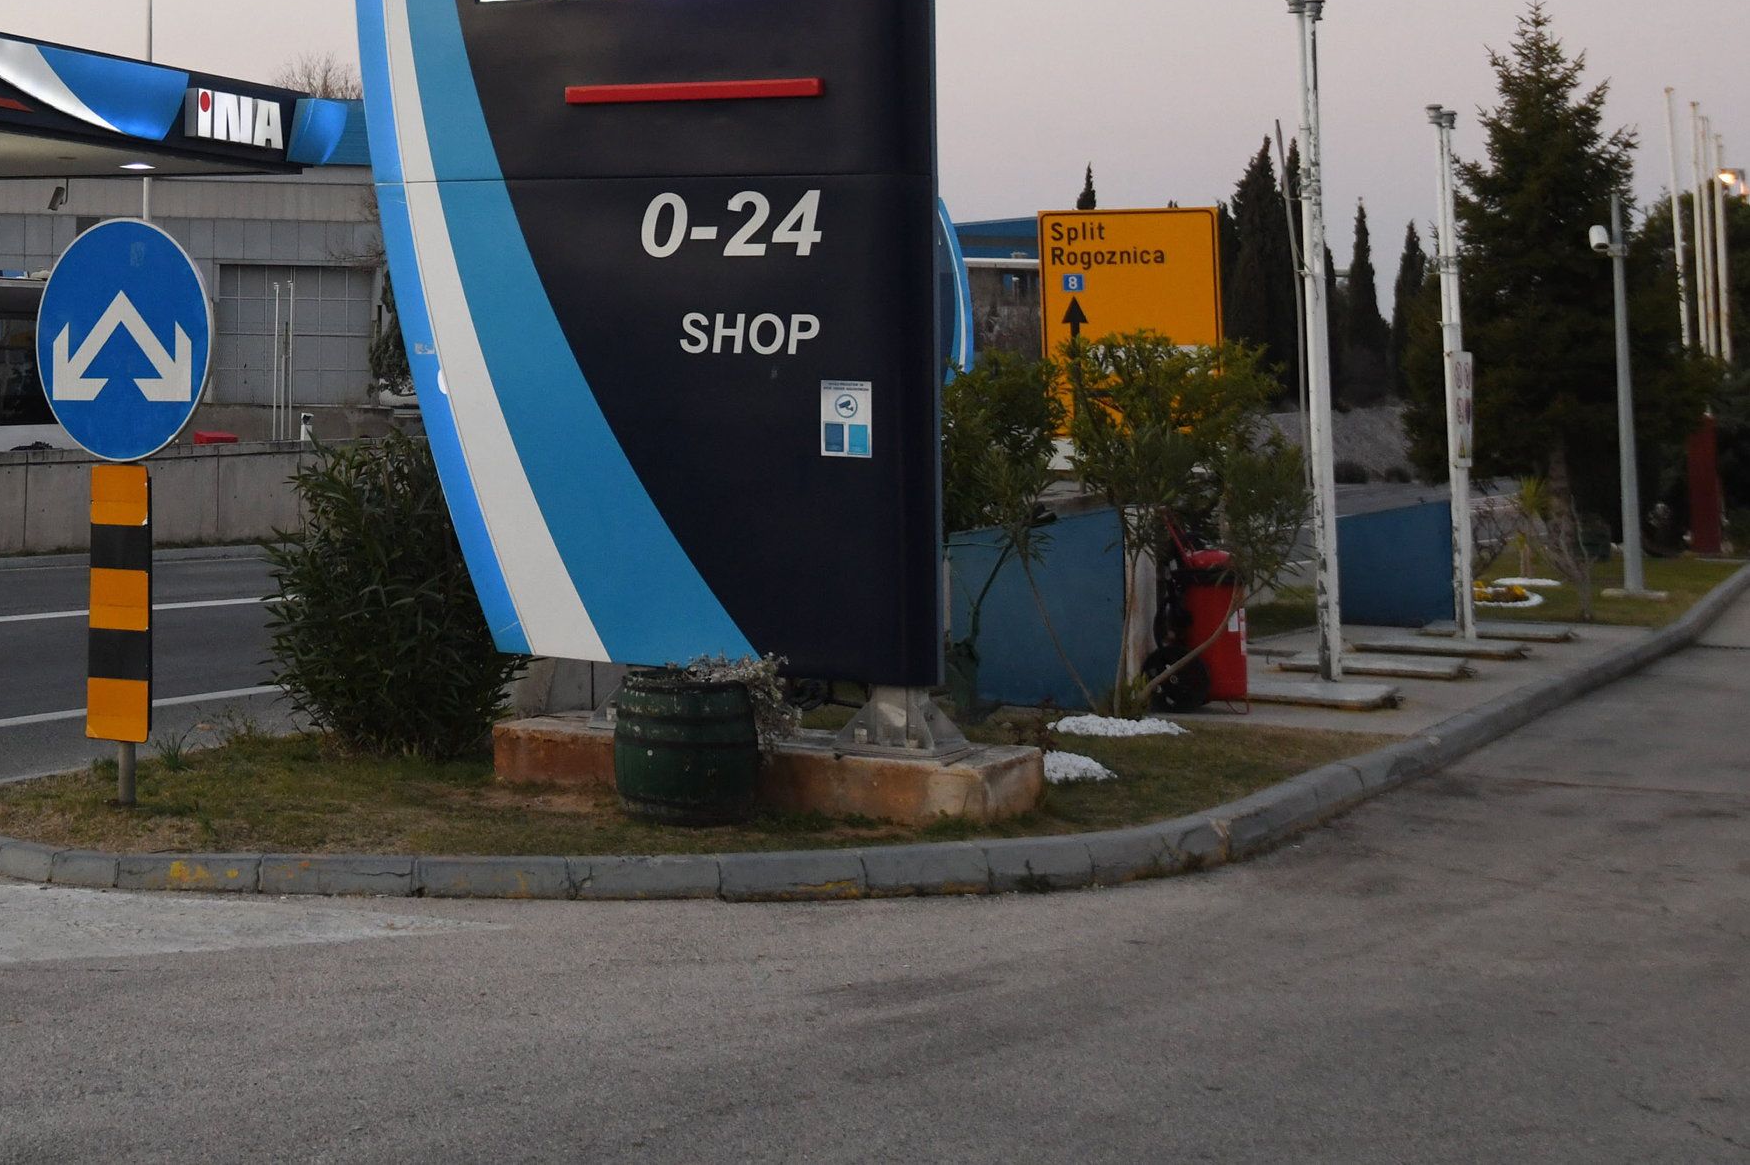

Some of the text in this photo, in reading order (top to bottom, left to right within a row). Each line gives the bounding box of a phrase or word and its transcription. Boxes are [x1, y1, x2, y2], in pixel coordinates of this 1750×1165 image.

[640, 189, 823, 259] 0-24
[1051, 221, 1106, 246] Split
[1051, 246, 1166, 270] Rogoznica
[1068, 275, 1079, 291] 8
[679, 312, 821, 355] SHOP
